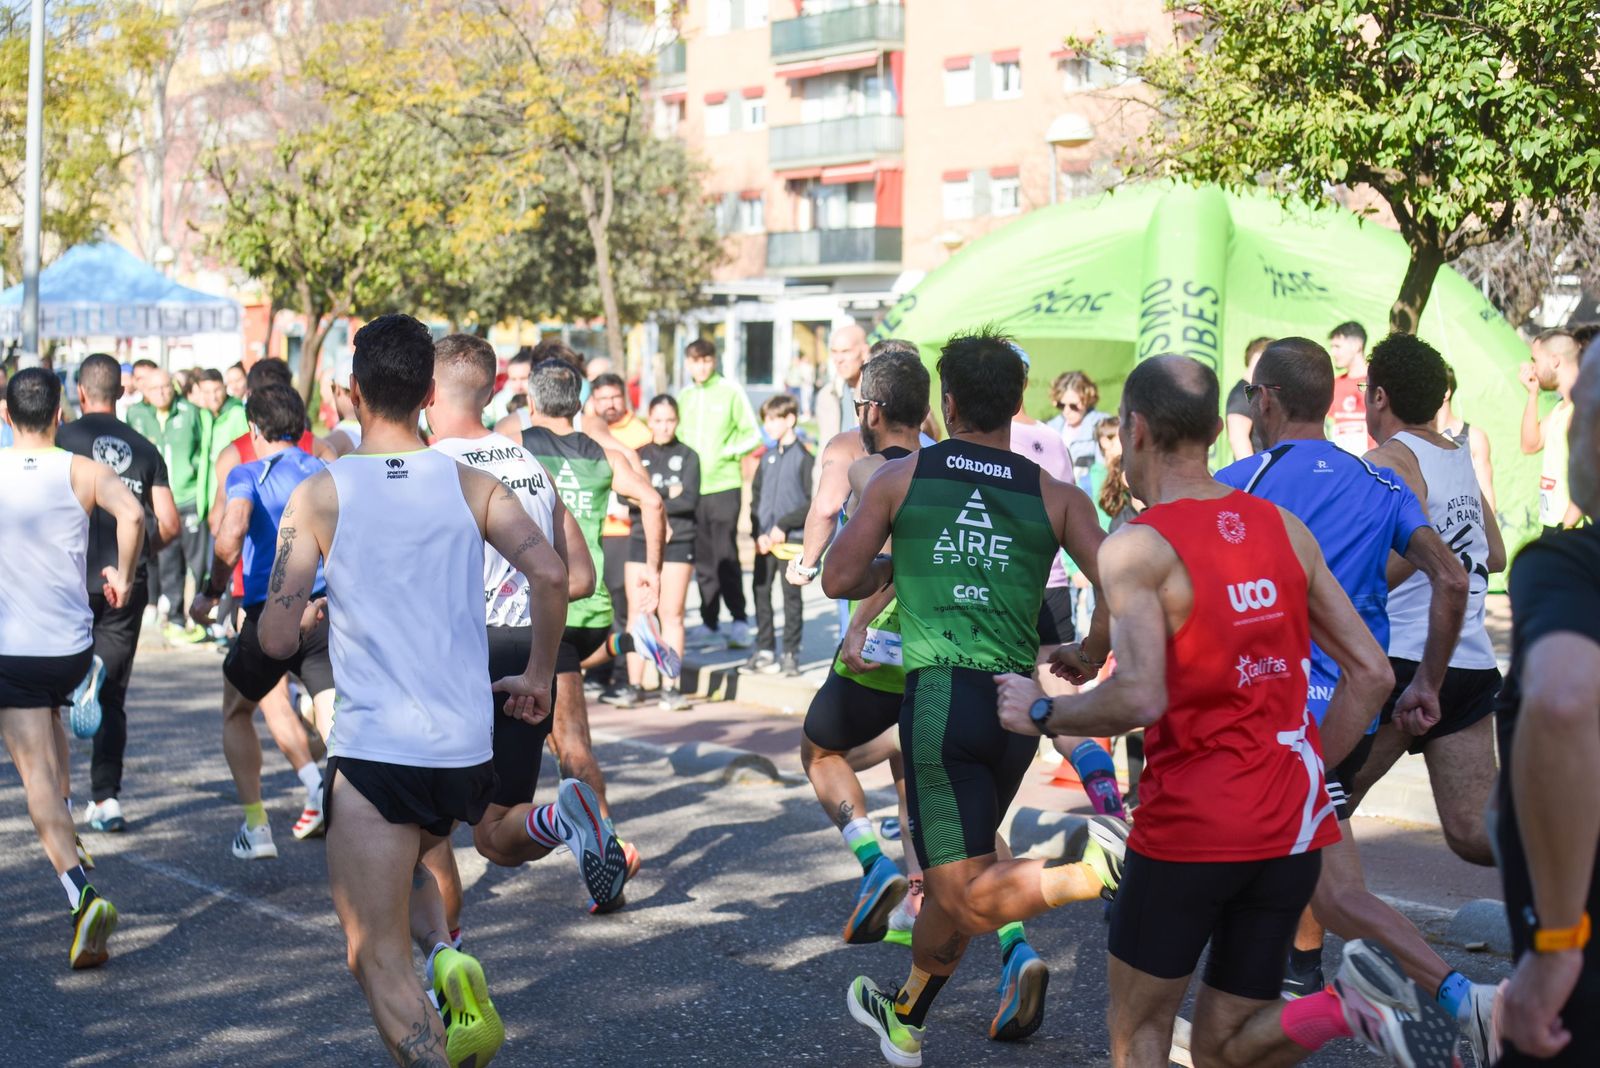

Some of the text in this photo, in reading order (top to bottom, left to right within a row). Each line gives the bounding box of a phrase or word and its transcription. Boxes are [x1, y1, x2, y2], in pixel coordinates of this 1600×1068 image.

[946, 454, 1013, 480] CÓRDOBA
[558, 490, 594, 510] RE
[1436, 516, 1454, 534] LA
[933, 527, 1013, 560] AIRE
[933, 553, 1009, 573] SPORT
[953, 584, 990, 601] CAC
[1227, 578, 1278, 613] UCO
